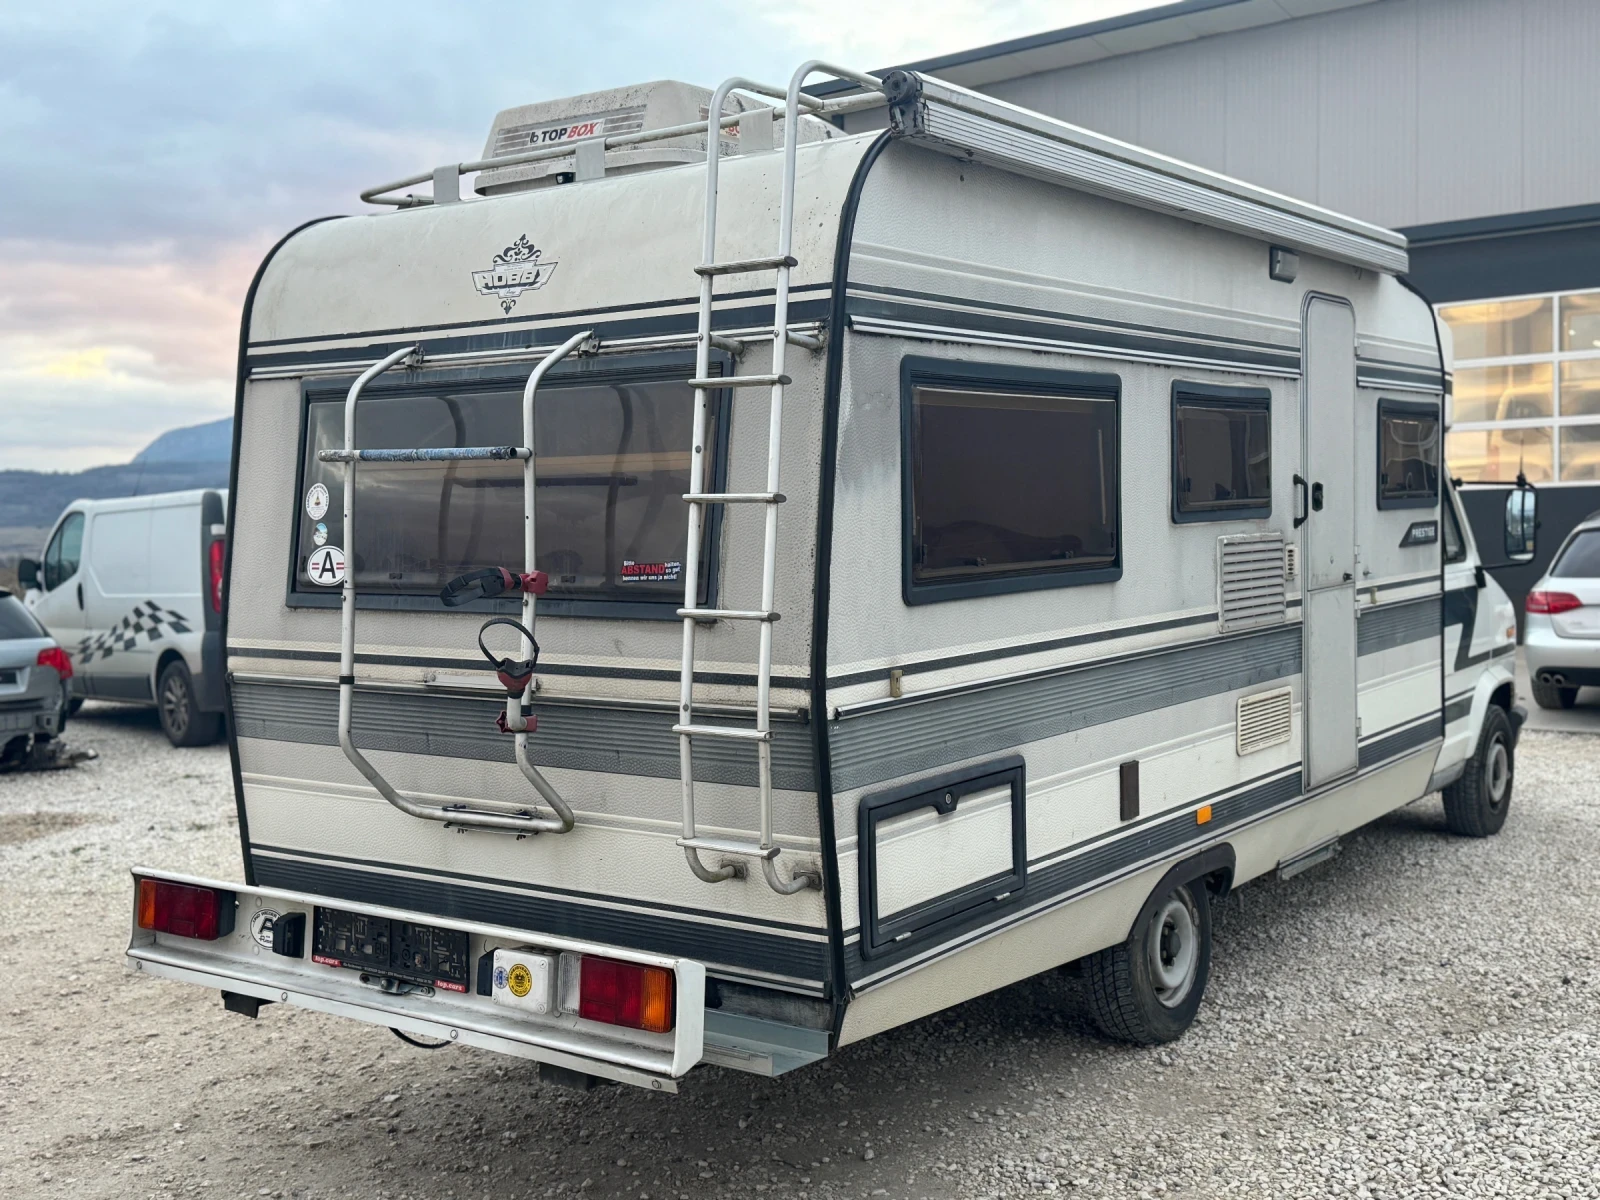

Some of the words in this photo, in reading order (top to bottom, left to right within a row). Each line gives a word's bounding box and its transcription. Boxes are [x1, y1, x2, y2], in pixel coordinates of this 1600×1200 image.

[318, 551, 336, 579] A
[621, 564, 665, 575] ABSTAND
[314, 955, 338, 965] top.cars
[437, 980, 463, 991] top.cars
